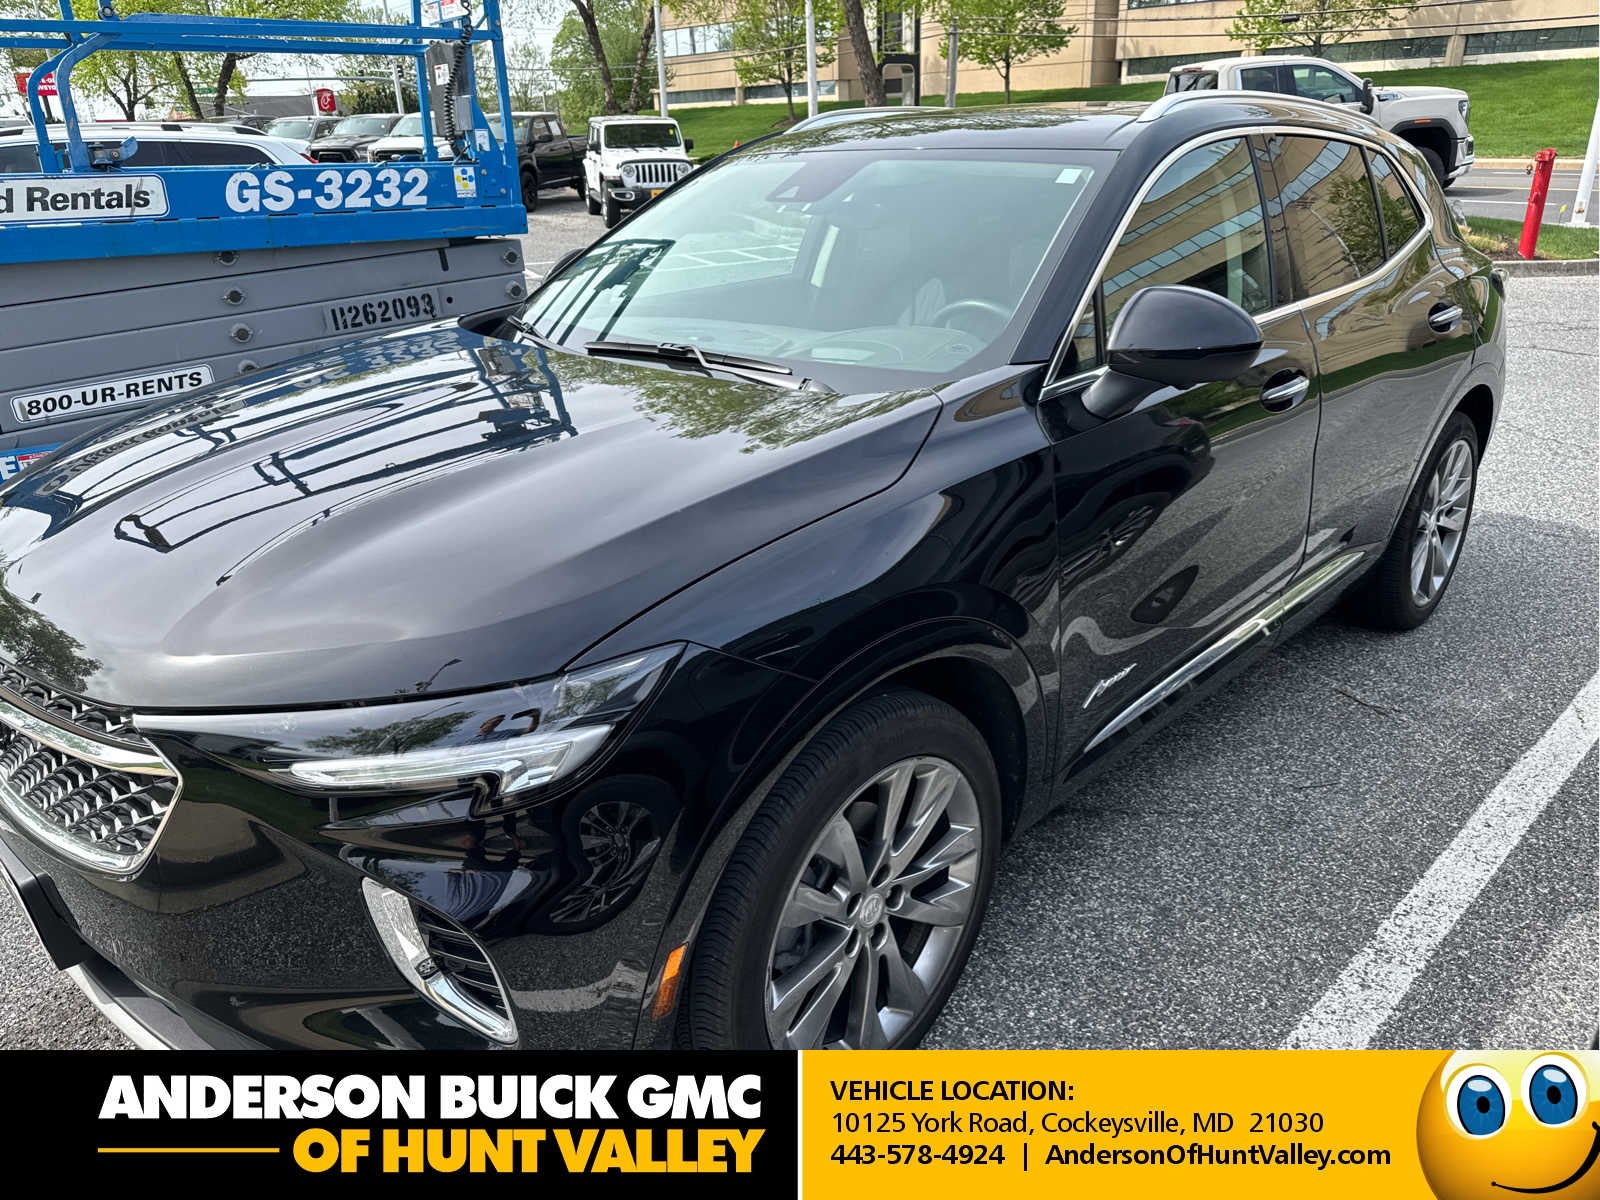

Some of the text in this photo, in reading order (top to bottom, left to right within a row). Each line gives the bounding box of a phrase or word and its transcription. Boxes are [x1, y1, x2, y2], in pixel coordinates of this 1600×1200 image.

[26, 184, 150, 212] Rentals
[225, 168, 429, 213] GS-3232
[27, 371, 202, 416] 800-UR-RENTS
